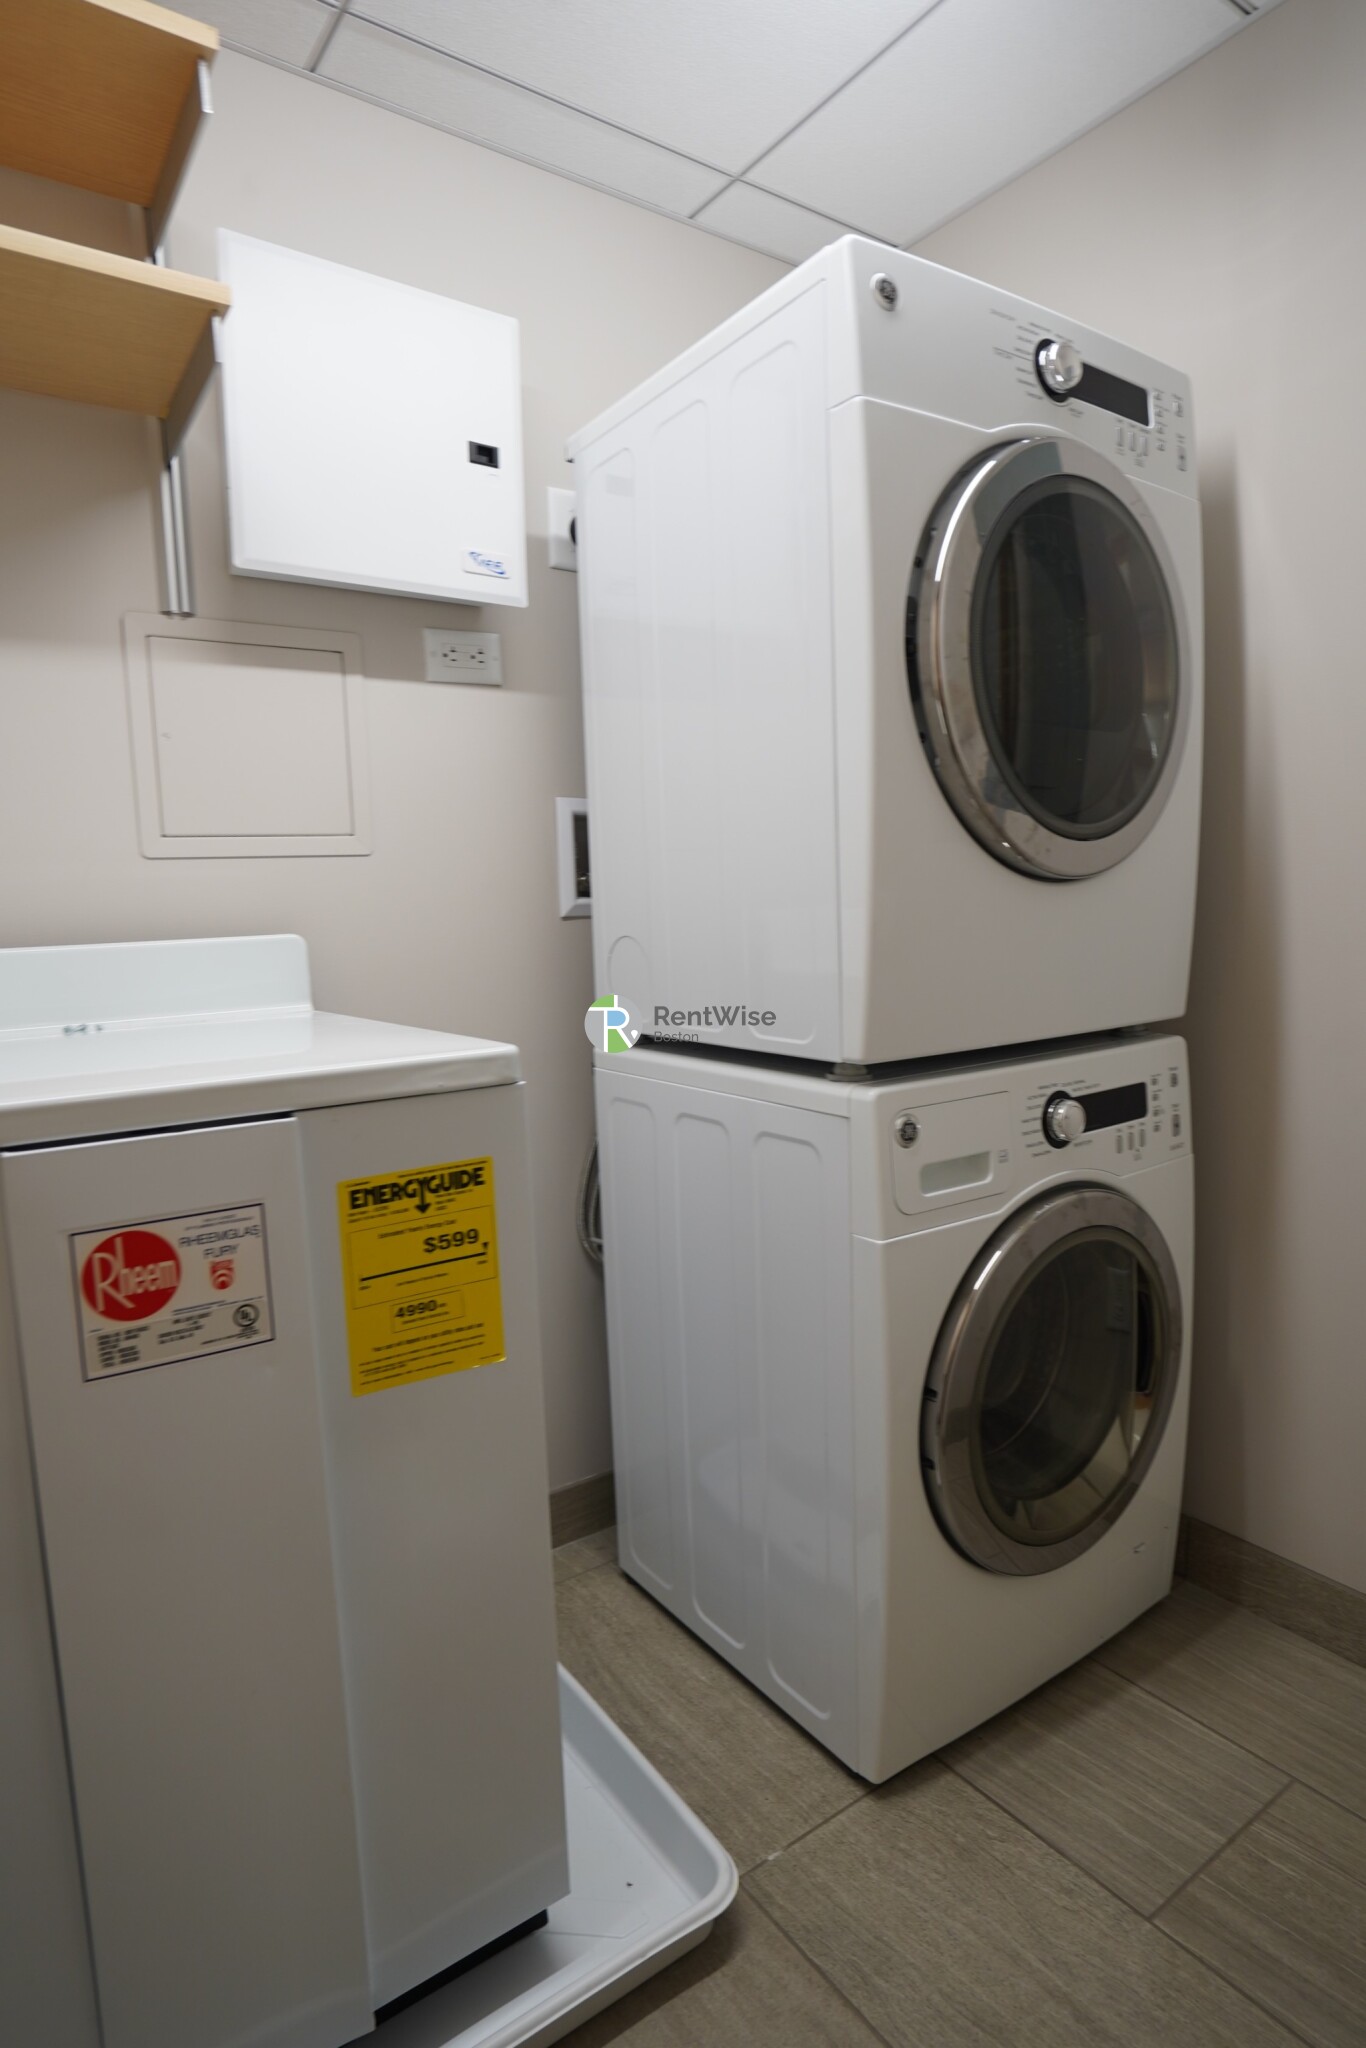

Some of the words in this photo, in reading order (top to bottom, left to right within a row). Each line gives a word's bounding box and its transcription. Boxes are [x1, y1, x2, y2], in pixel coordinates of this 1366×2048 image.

[423, 1228, 479, 1253] $599
[91, 1236, 178, 1312] Rheem
[395, 1299, 438, 1318] 4990
